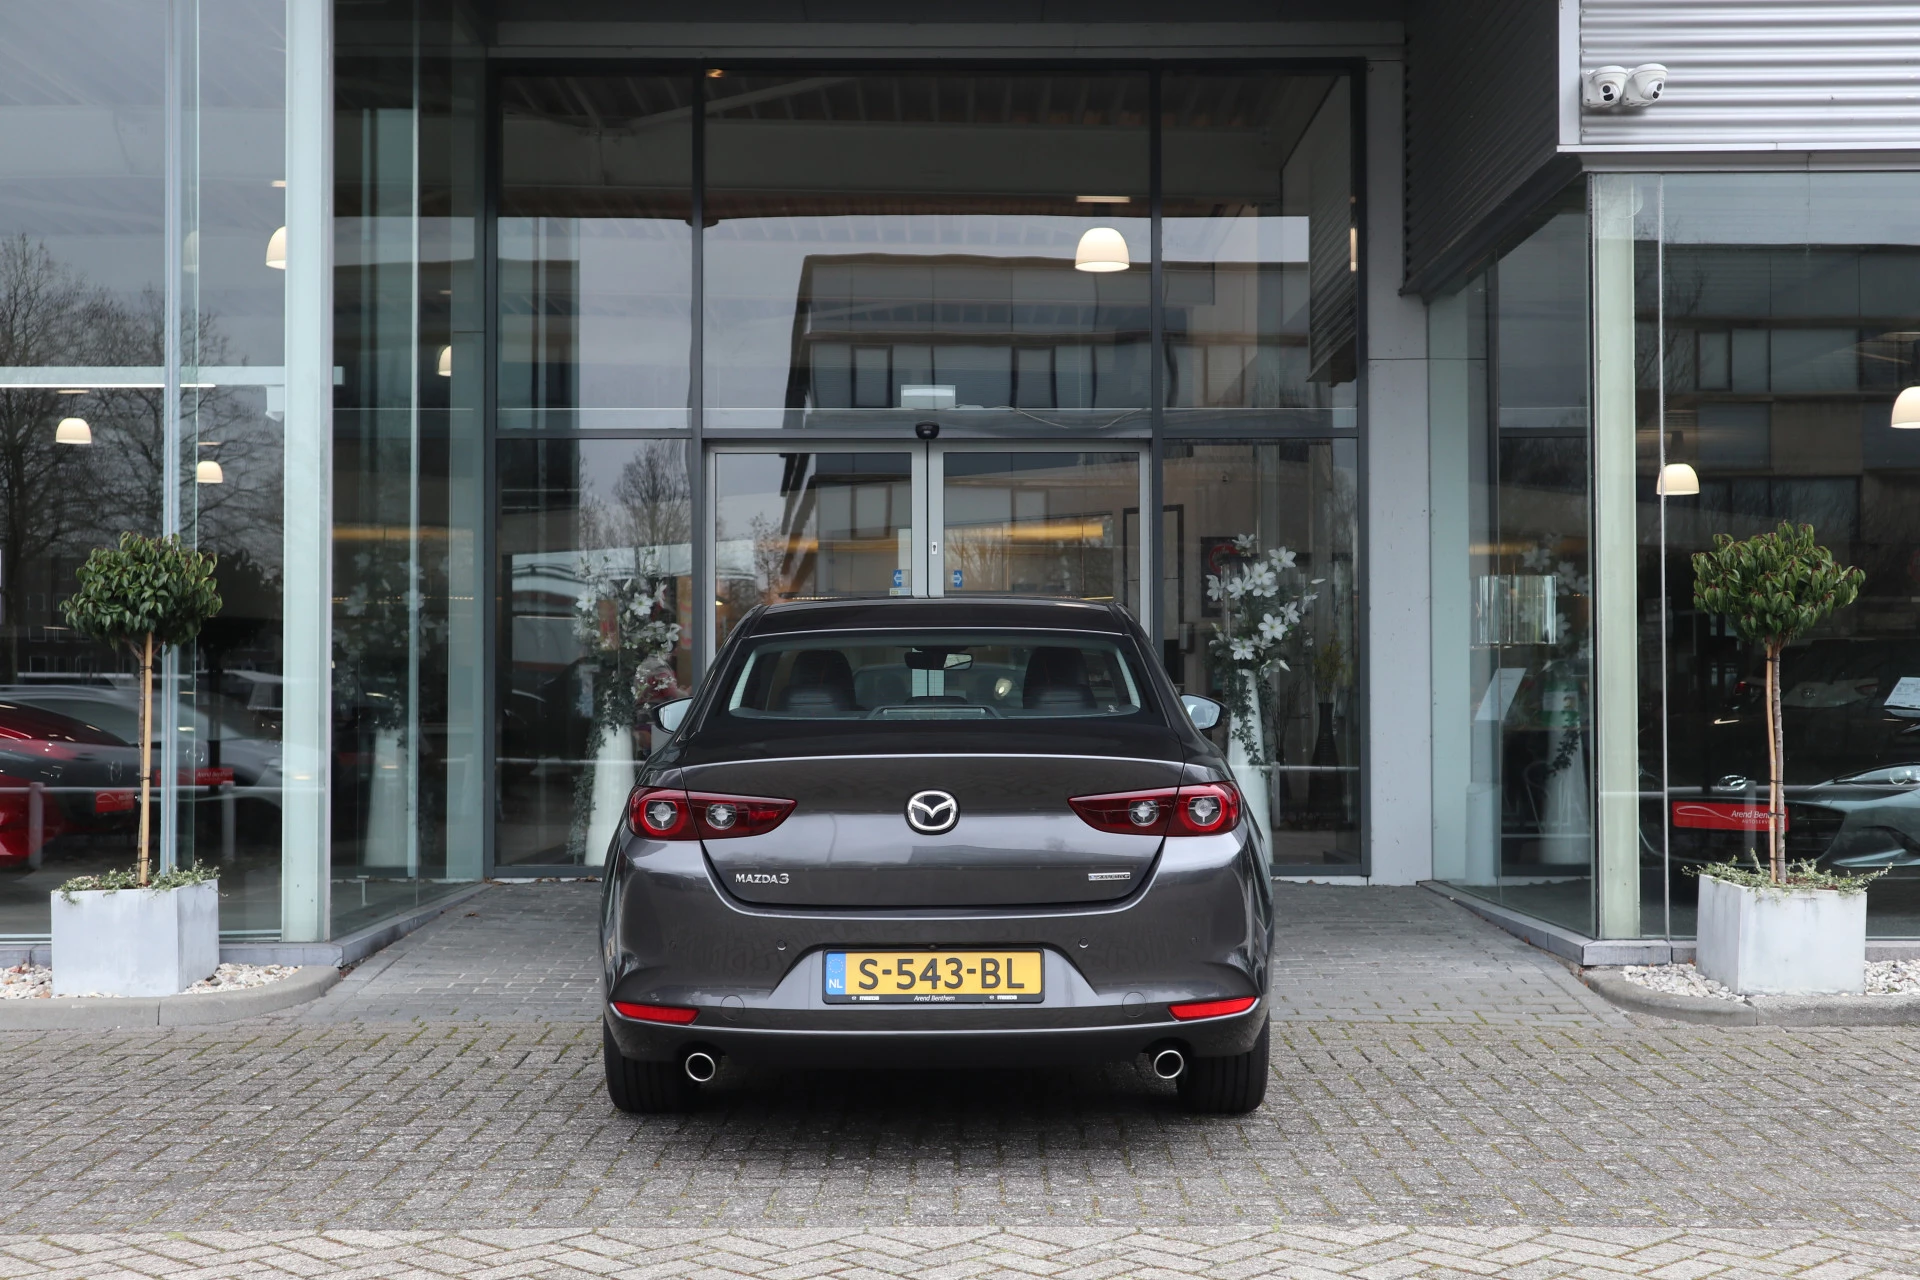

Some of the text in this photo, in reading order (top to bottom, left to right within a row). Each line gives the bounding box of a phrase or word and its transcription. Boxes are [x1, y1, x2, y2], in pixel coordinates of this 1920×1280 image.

[1731, 810, 1753, 819] Arend
[735, 873, 790, 884] MAZDA3
[858, 958, 1025, 990] S-543-BL
[828, 979, 843, 988] NL
[913, 994, 931, 1002] Arend
